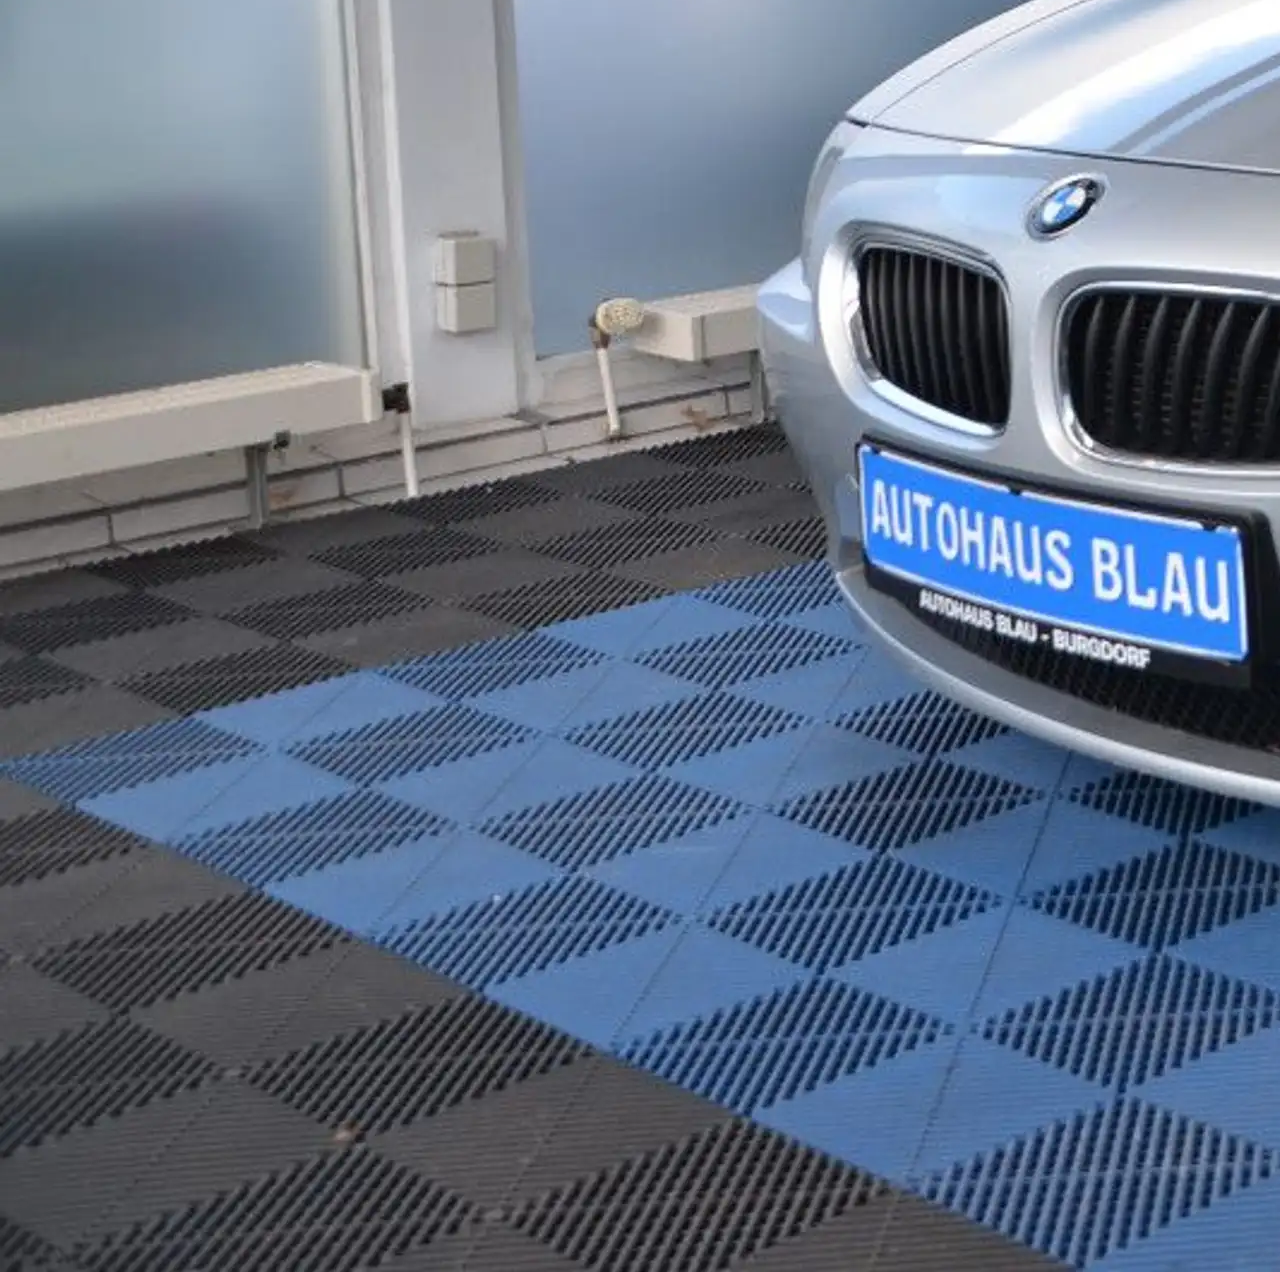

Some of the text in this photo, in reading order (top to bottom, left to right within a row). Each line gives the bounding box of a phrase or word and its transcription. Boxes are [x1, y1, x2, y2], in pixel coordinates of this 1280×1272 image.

[871, 478, 1231, 624] AUTOHAUS BLAU
[919, 588, 995, 631] AUTOHAUS
[996, 614, 1038, 643] BLAU
[1053, 628, 1151, 670] BURGDORF
